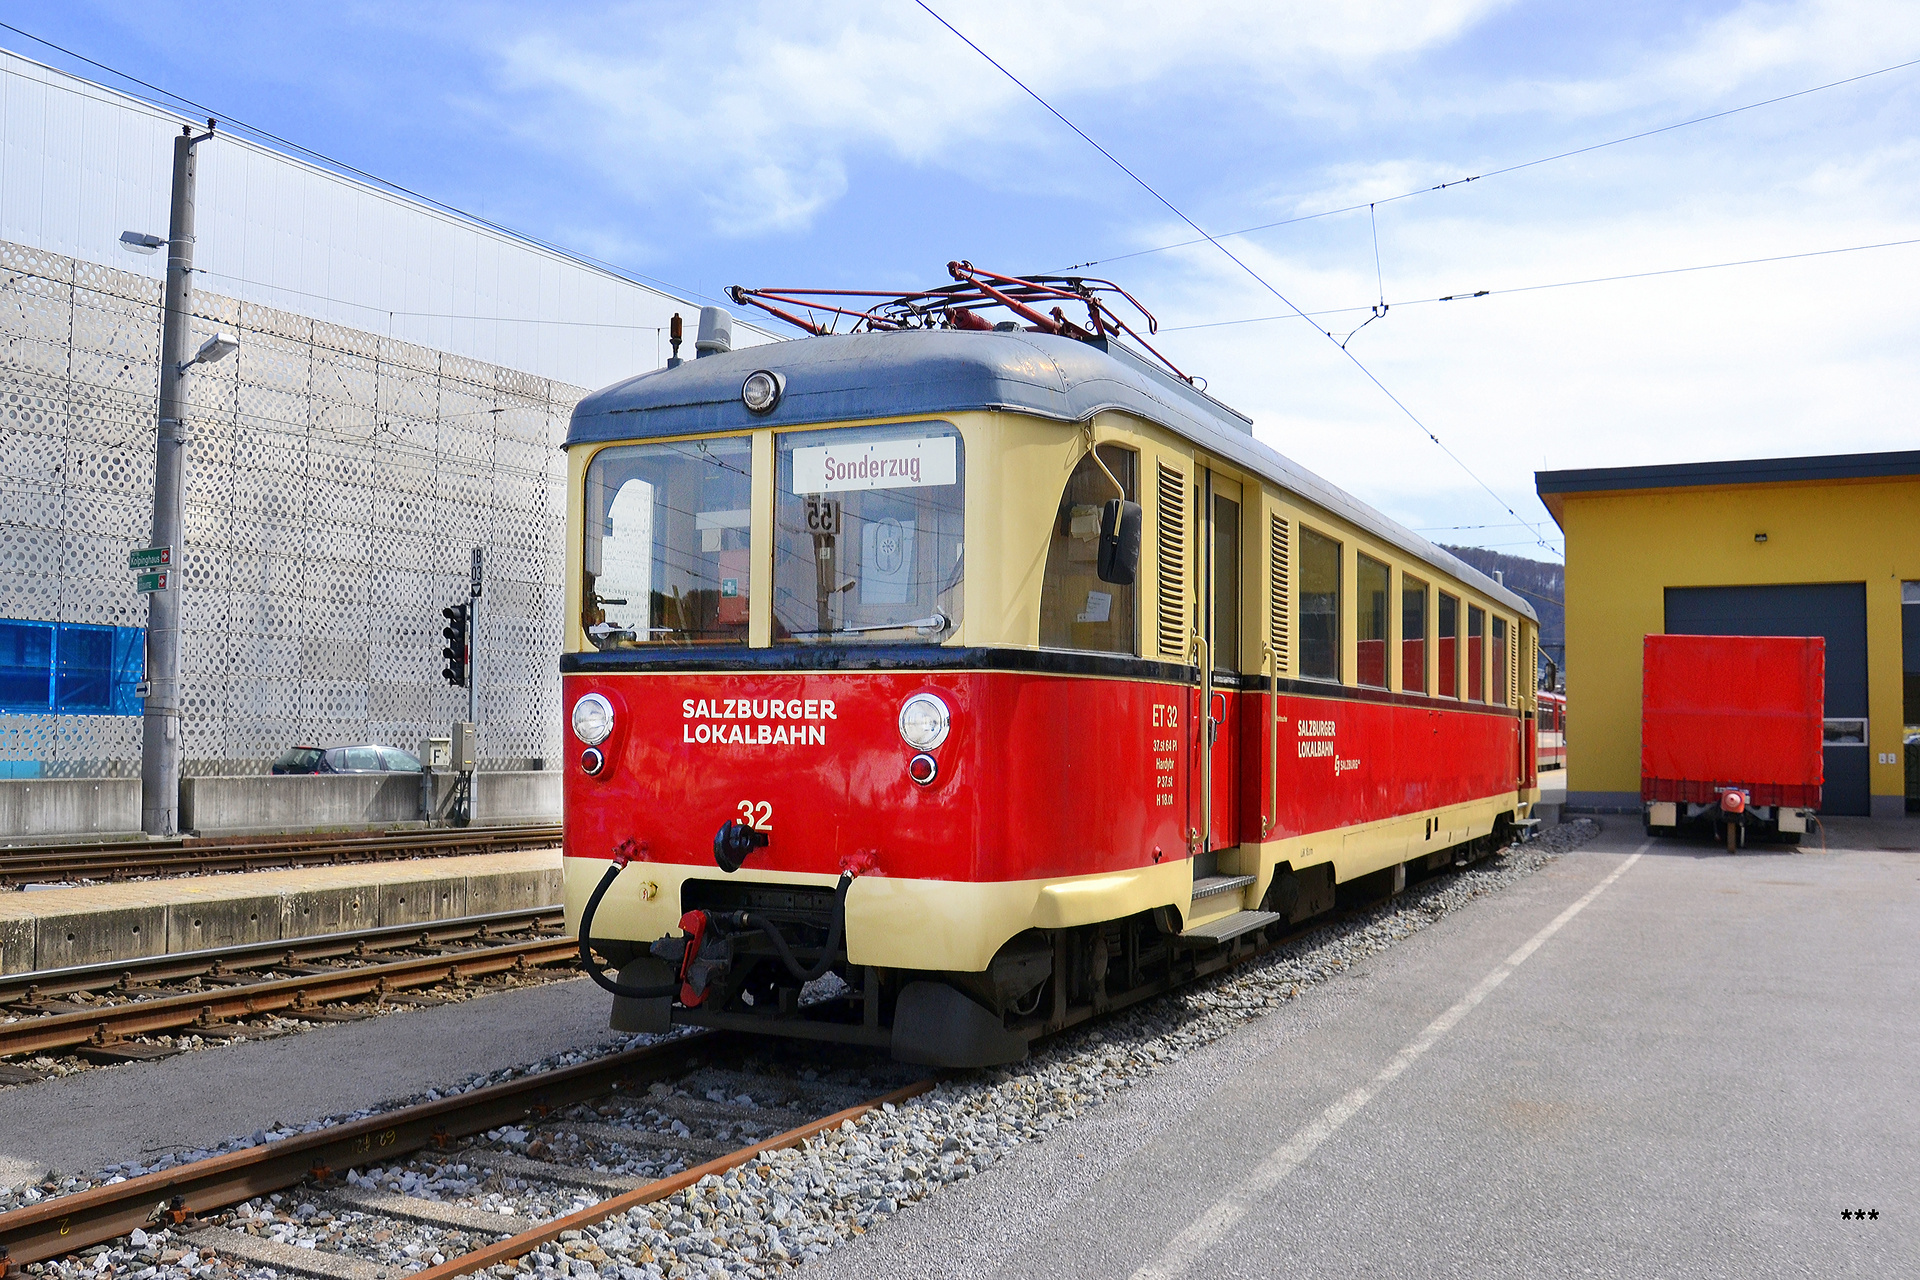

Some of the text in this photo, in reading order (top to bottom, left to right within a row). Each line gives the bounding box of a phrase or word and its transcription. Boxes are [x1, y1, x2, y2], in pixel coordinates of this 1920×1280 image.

[825, 454, 921, 482] Sonderzug
[471, 566, 482, 581] 03
[682, 699, 838, 719] SALZBURGER
[1152, 704, 1178, 727] ET 32
[683, 724, 826, 745] LOKALBAHN
[1297, 719, 1336, 736] SALZBURGER
[433, 749, 442, 764] F
[1297, 741, 1334, 758] LOKALBAHN
[1156, 776, 1161, 788] P
[1156, 794, 1161, 806] H
[736, 800, 773, 831] 32
